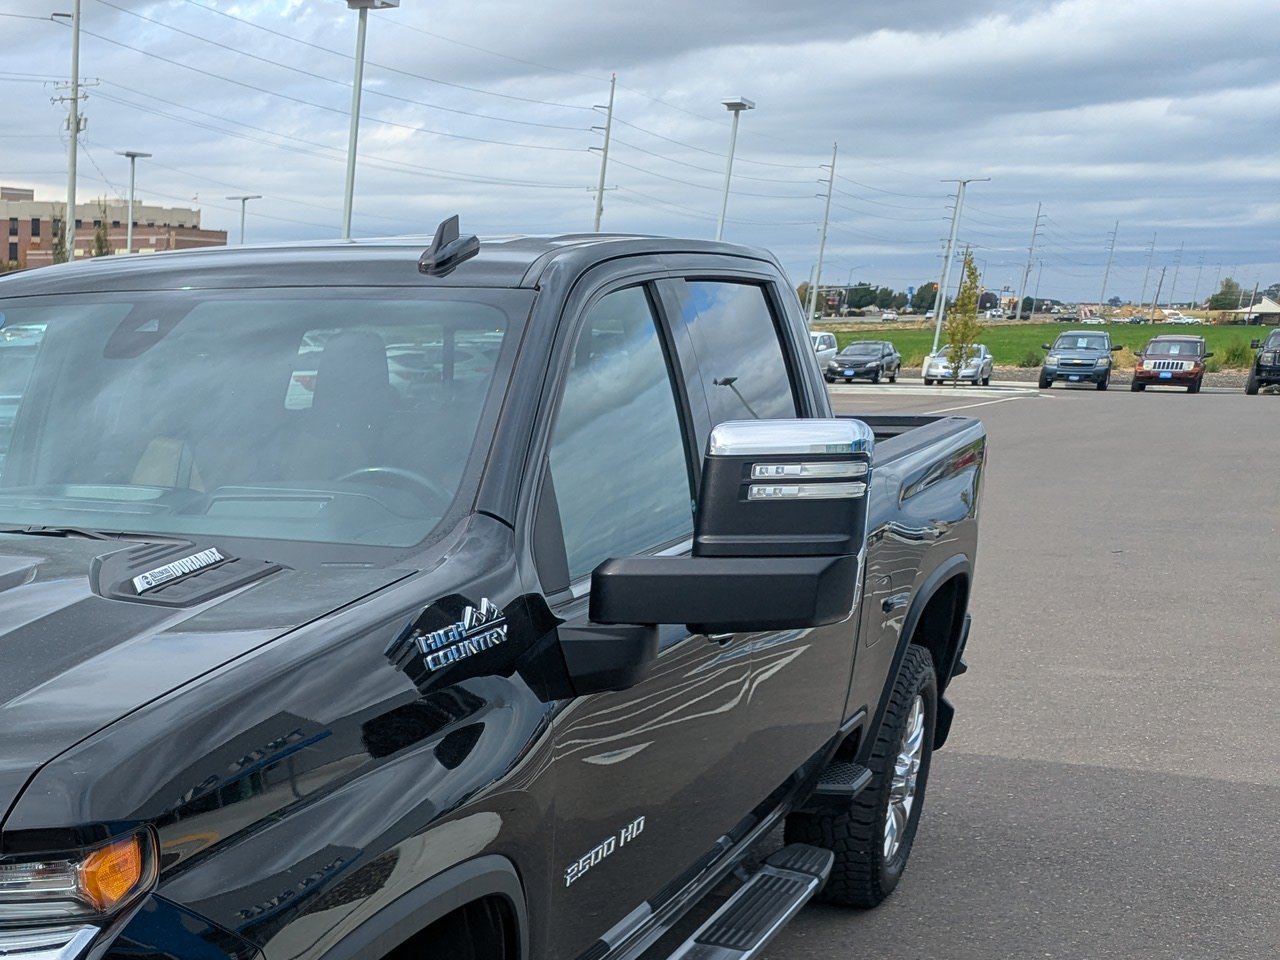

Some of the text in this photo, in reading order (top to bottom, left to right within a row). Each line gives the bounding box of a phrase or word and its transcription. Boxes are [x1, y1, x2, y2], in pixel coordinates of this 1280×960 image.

[169, 548, 225, 577] DURAMAX
[416, 622, 467, 654] HIGH
[423, 624, 508, 672] COUNTRY
[564, 816, 645, 887] 2500 HD
